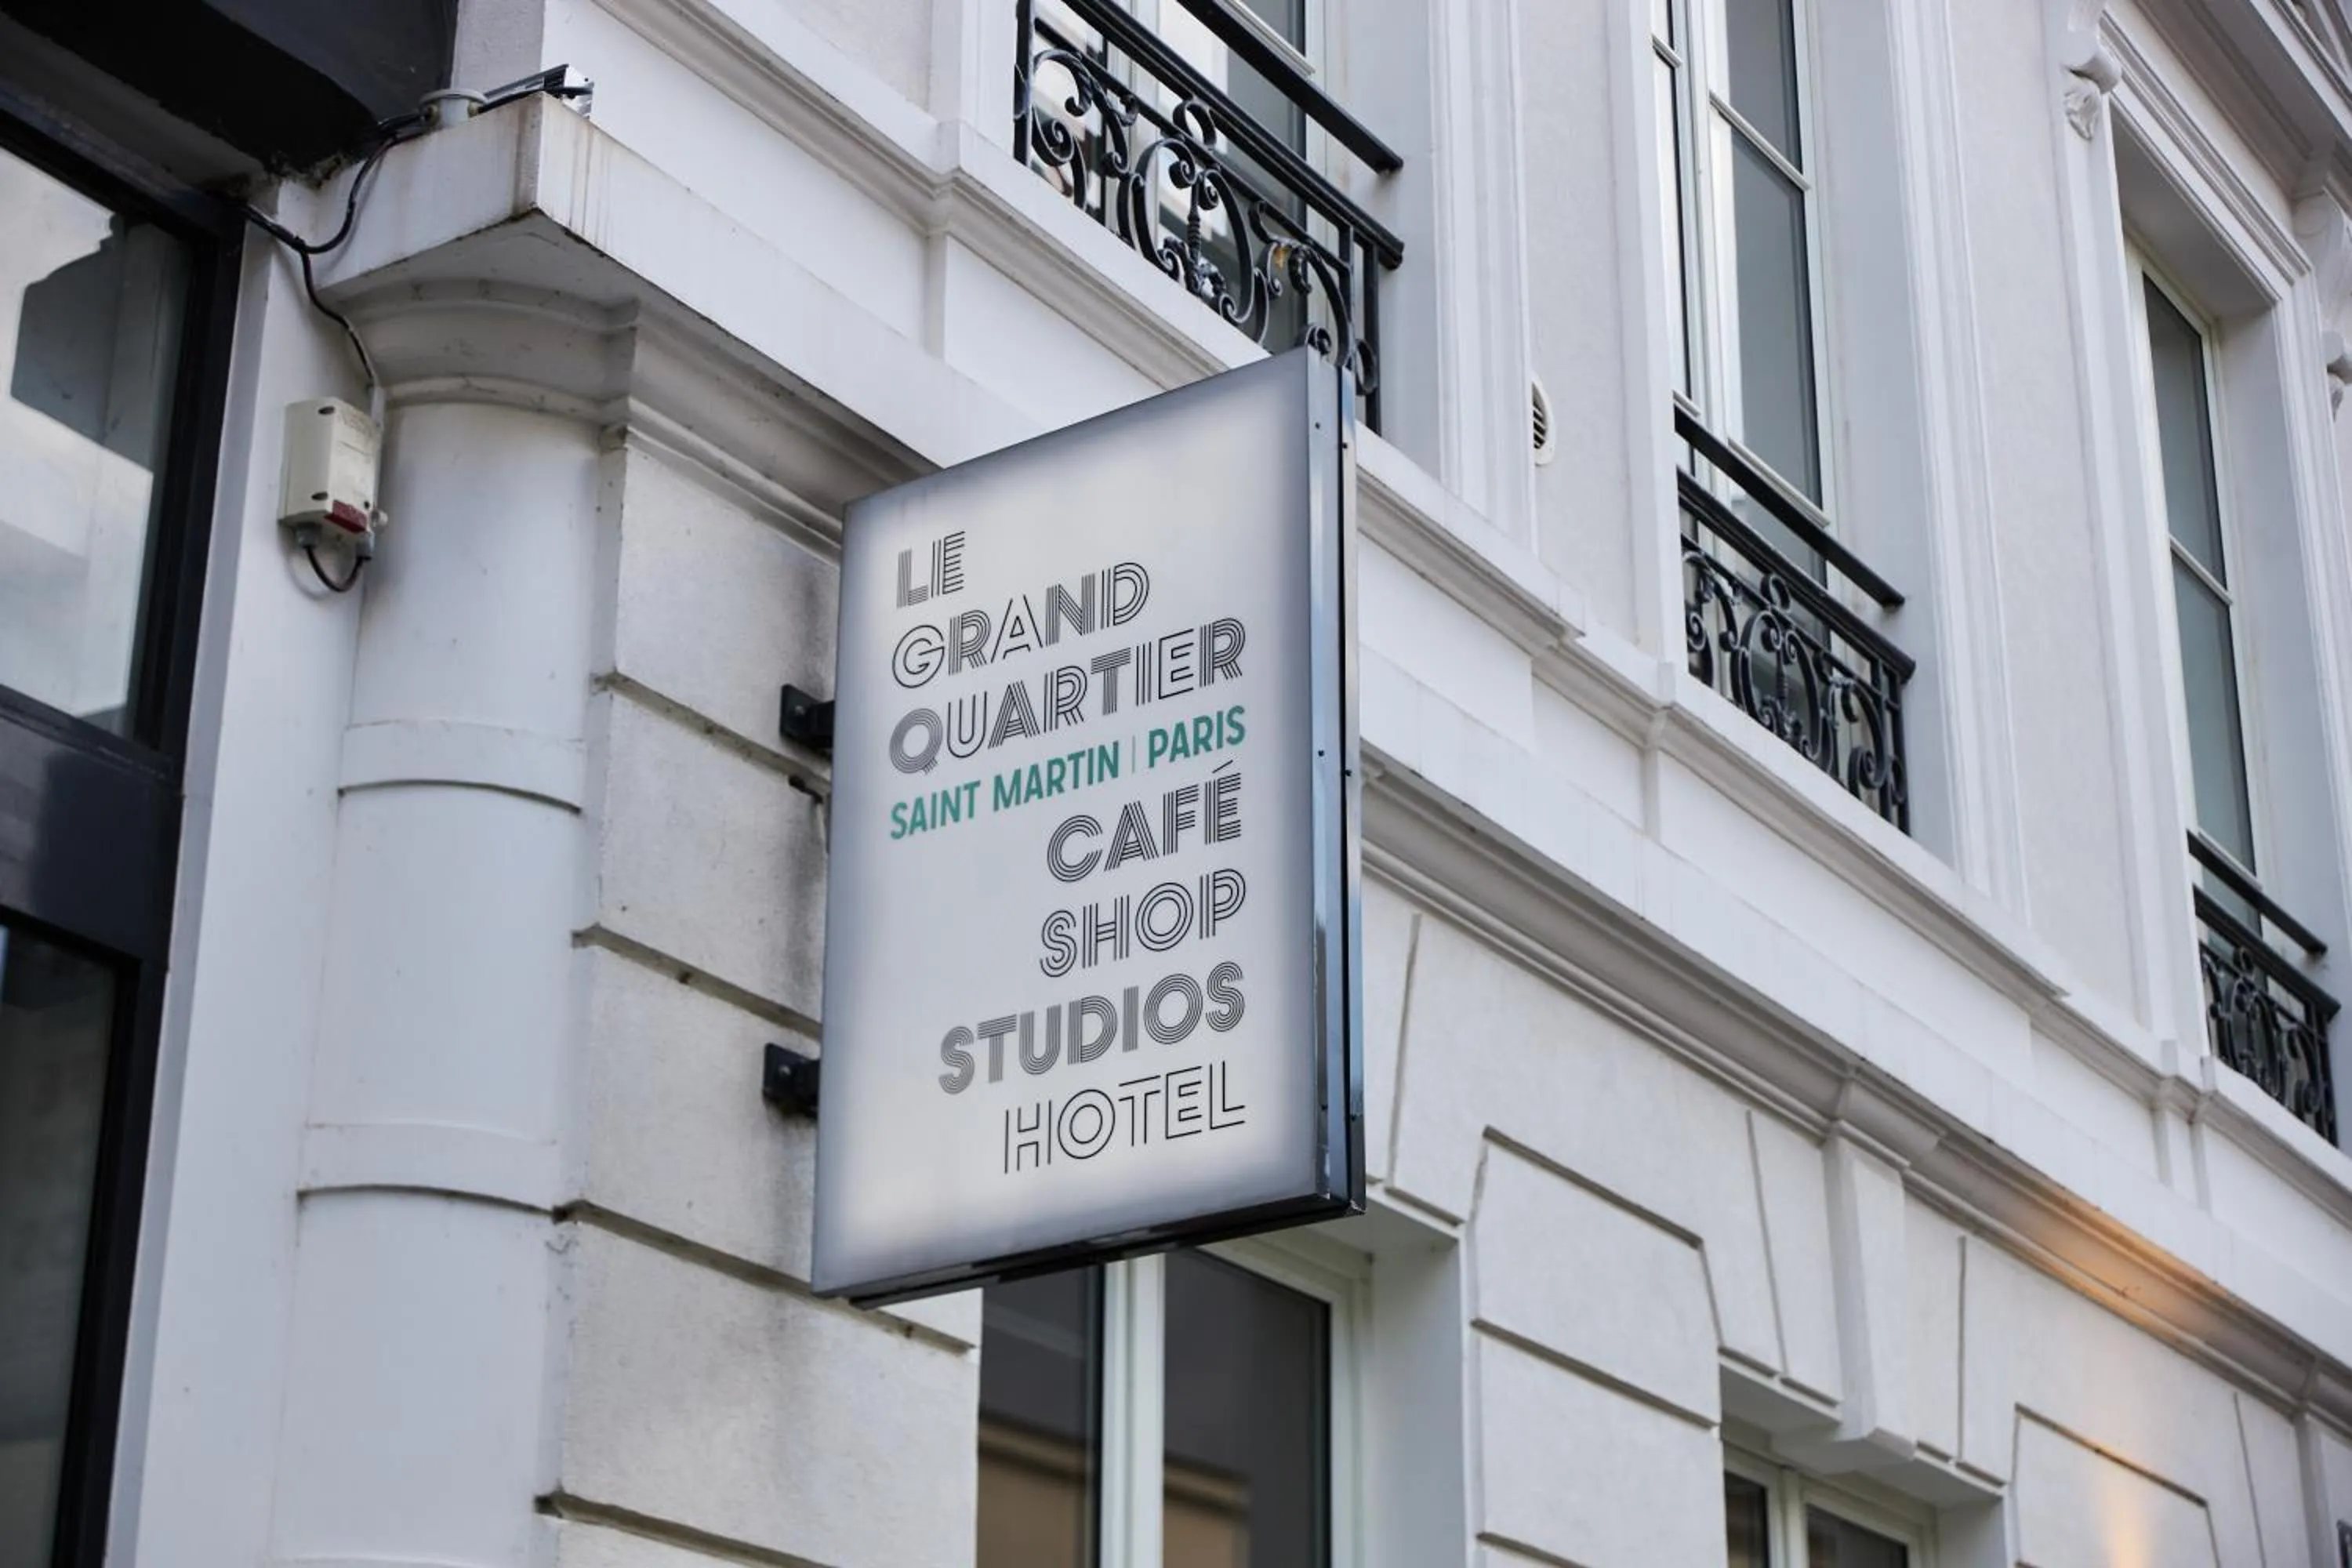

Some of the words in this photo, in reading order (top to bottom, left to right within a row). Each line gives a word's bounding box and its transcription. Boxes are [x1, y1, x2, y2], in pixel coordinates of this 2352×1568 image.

[891, 561, 1150, 690] GRAND
[897, 530, 966, 608] LE
[888, 616, 1246, 775] QUARTIER
[890, 779, 982, 840] SAINT
[993, 739, 1120, 813] MARTIN
[1148, 705, 1246, 769] PARIS
[1046, 759, 1243, 884] CAFÉ
[1039, 868, 1247, 978] SHOP
[938, 960, 1246, 1096] STUDIOS
[1004, 1060, 1246, 1174] HOTEL
